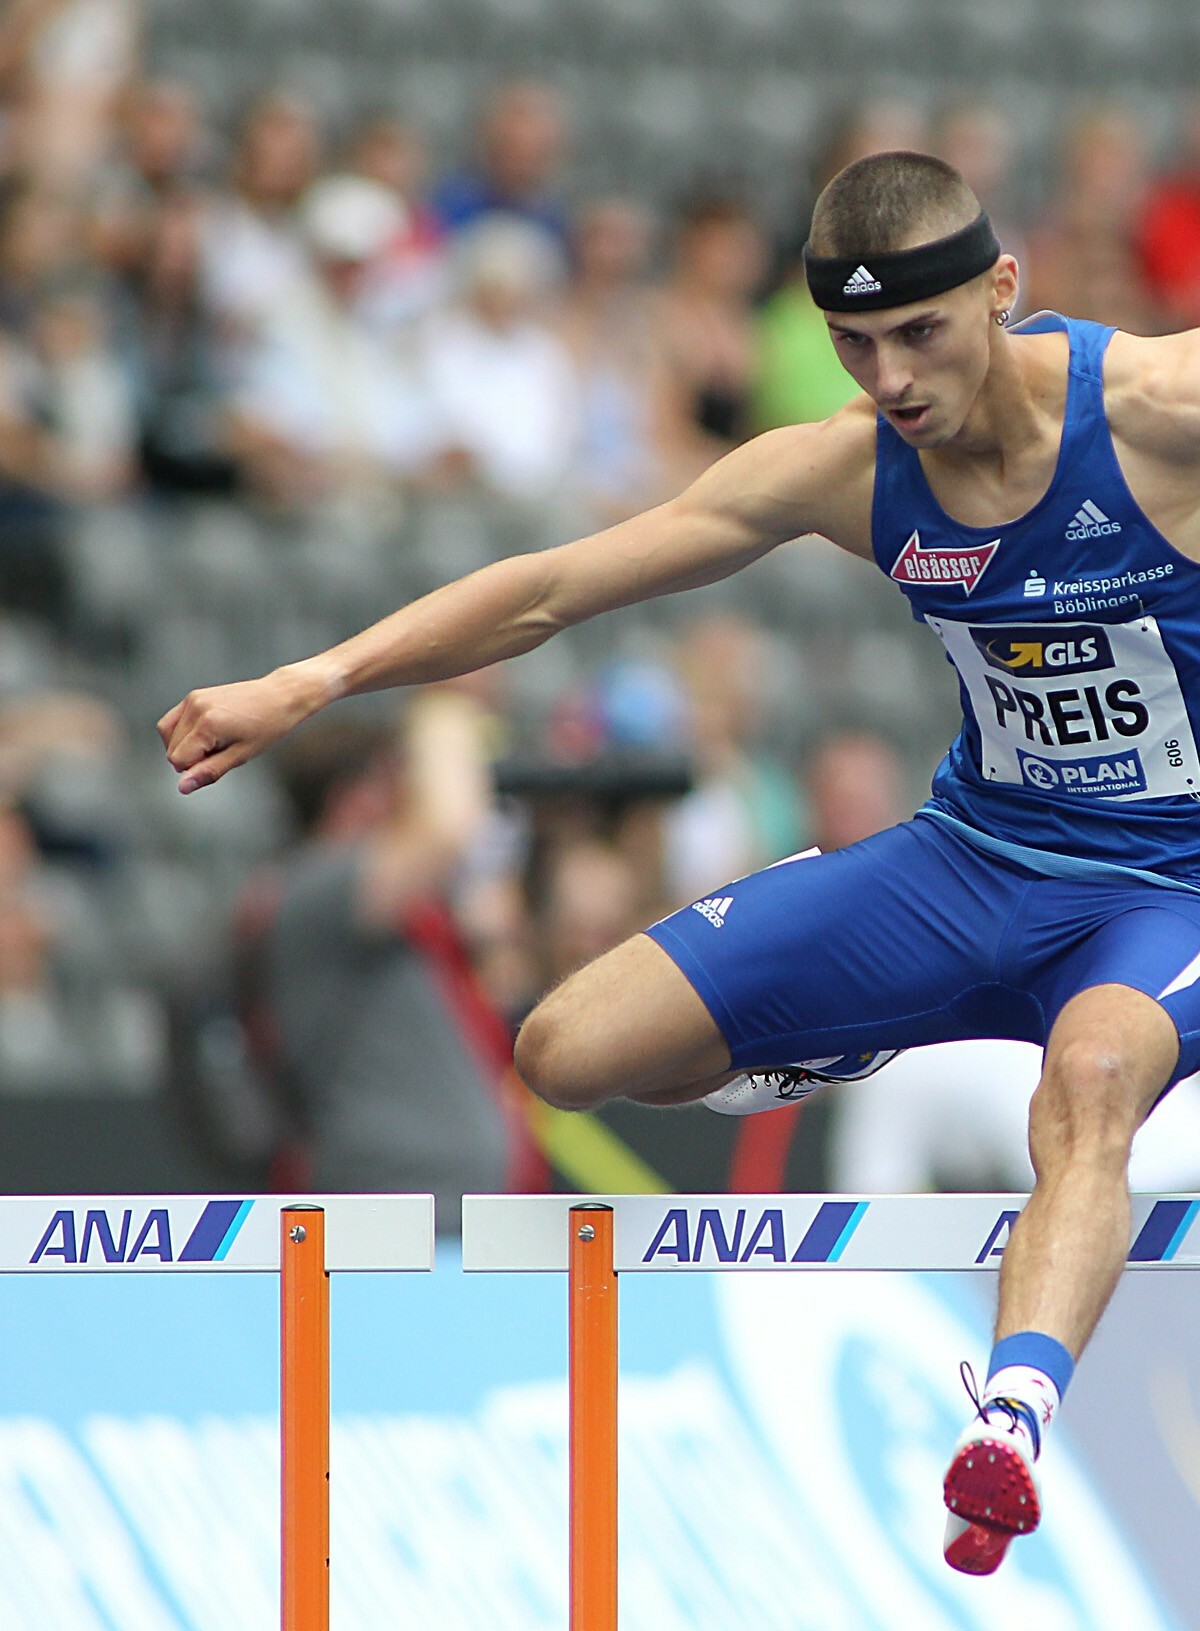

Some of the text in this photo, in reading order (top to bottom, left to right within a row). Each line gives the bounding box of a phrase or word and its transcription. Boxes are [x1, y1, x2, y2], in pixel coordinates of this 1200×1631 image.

[843, 281, 882, 294] adidas
[1065, 521, 1122, 541] adidas
[904, 553, 981, 579] elsässer
[1053, 563, 1174, 595] Kreissparkasse
[1044, 637, 1098, 666] GLS
[984, 674, 1150, 746] PREIS
[1060, 758, 1139, 785] PLAN
[1067, 780, 1141, 794] INTERNATIONAL
[691, 901, 725, 929] adidas
[29, 1209, 173, 1264] ANA
[641, 1208, 787, 1263] ANA
